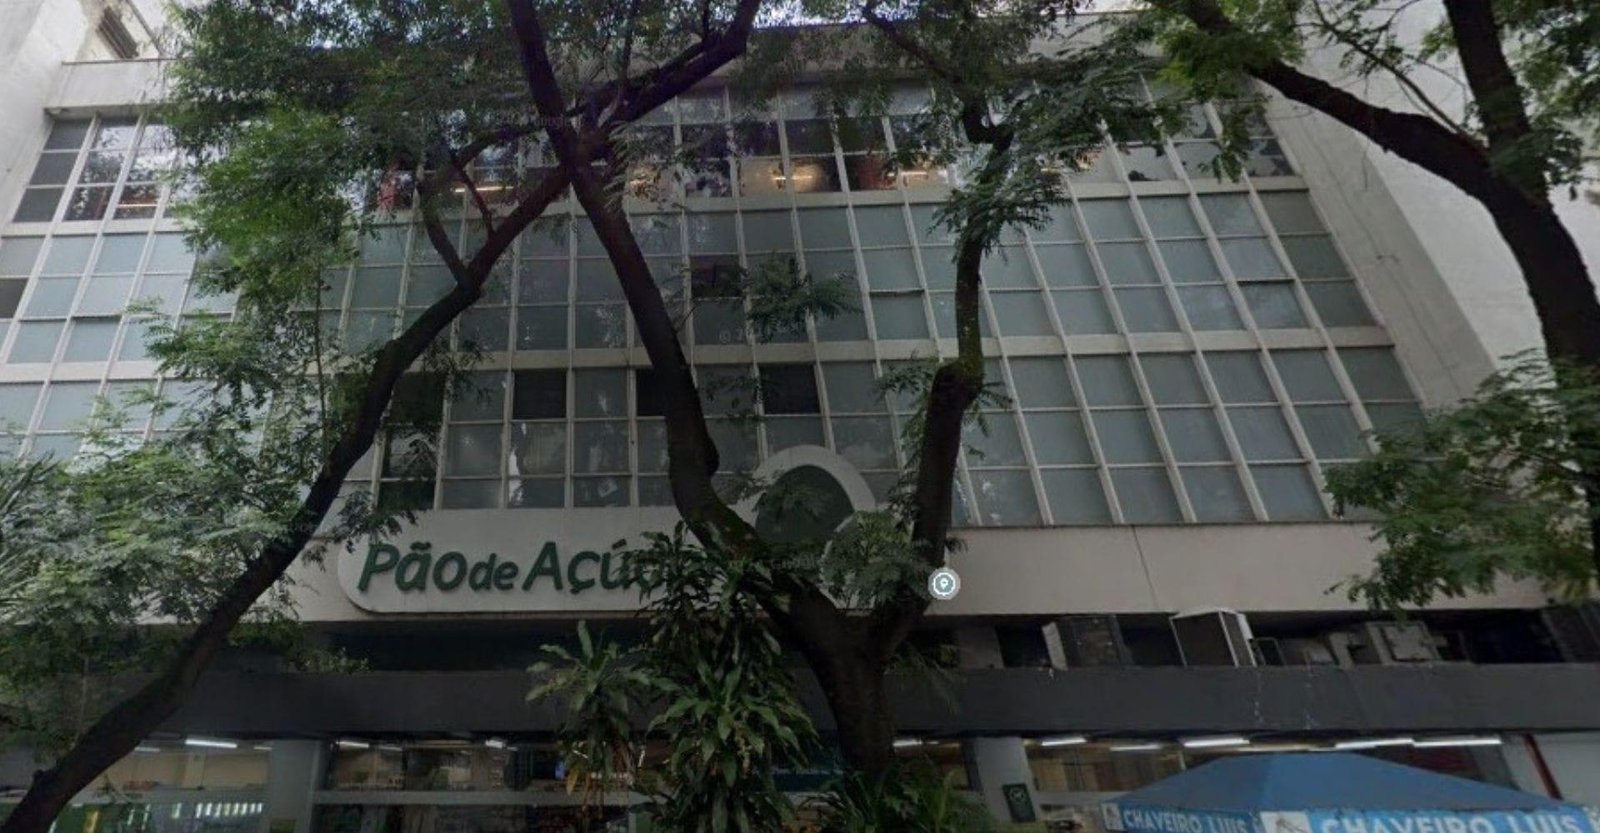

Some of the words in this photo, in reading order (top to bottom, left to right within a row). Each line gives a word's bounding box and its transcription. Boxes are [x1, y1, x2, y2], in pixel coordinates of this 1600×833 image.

[357, 541, 467, 592] Pão
[469, 553, 519, 591] de
[1123, 809, 1201, 833] CHAVEIRO
[1206, 812, 1248, 833] LUIS
[1321, 814, 1495, 833] CHAVEIRO
[1505, 812, 1580, 833] LUIS
